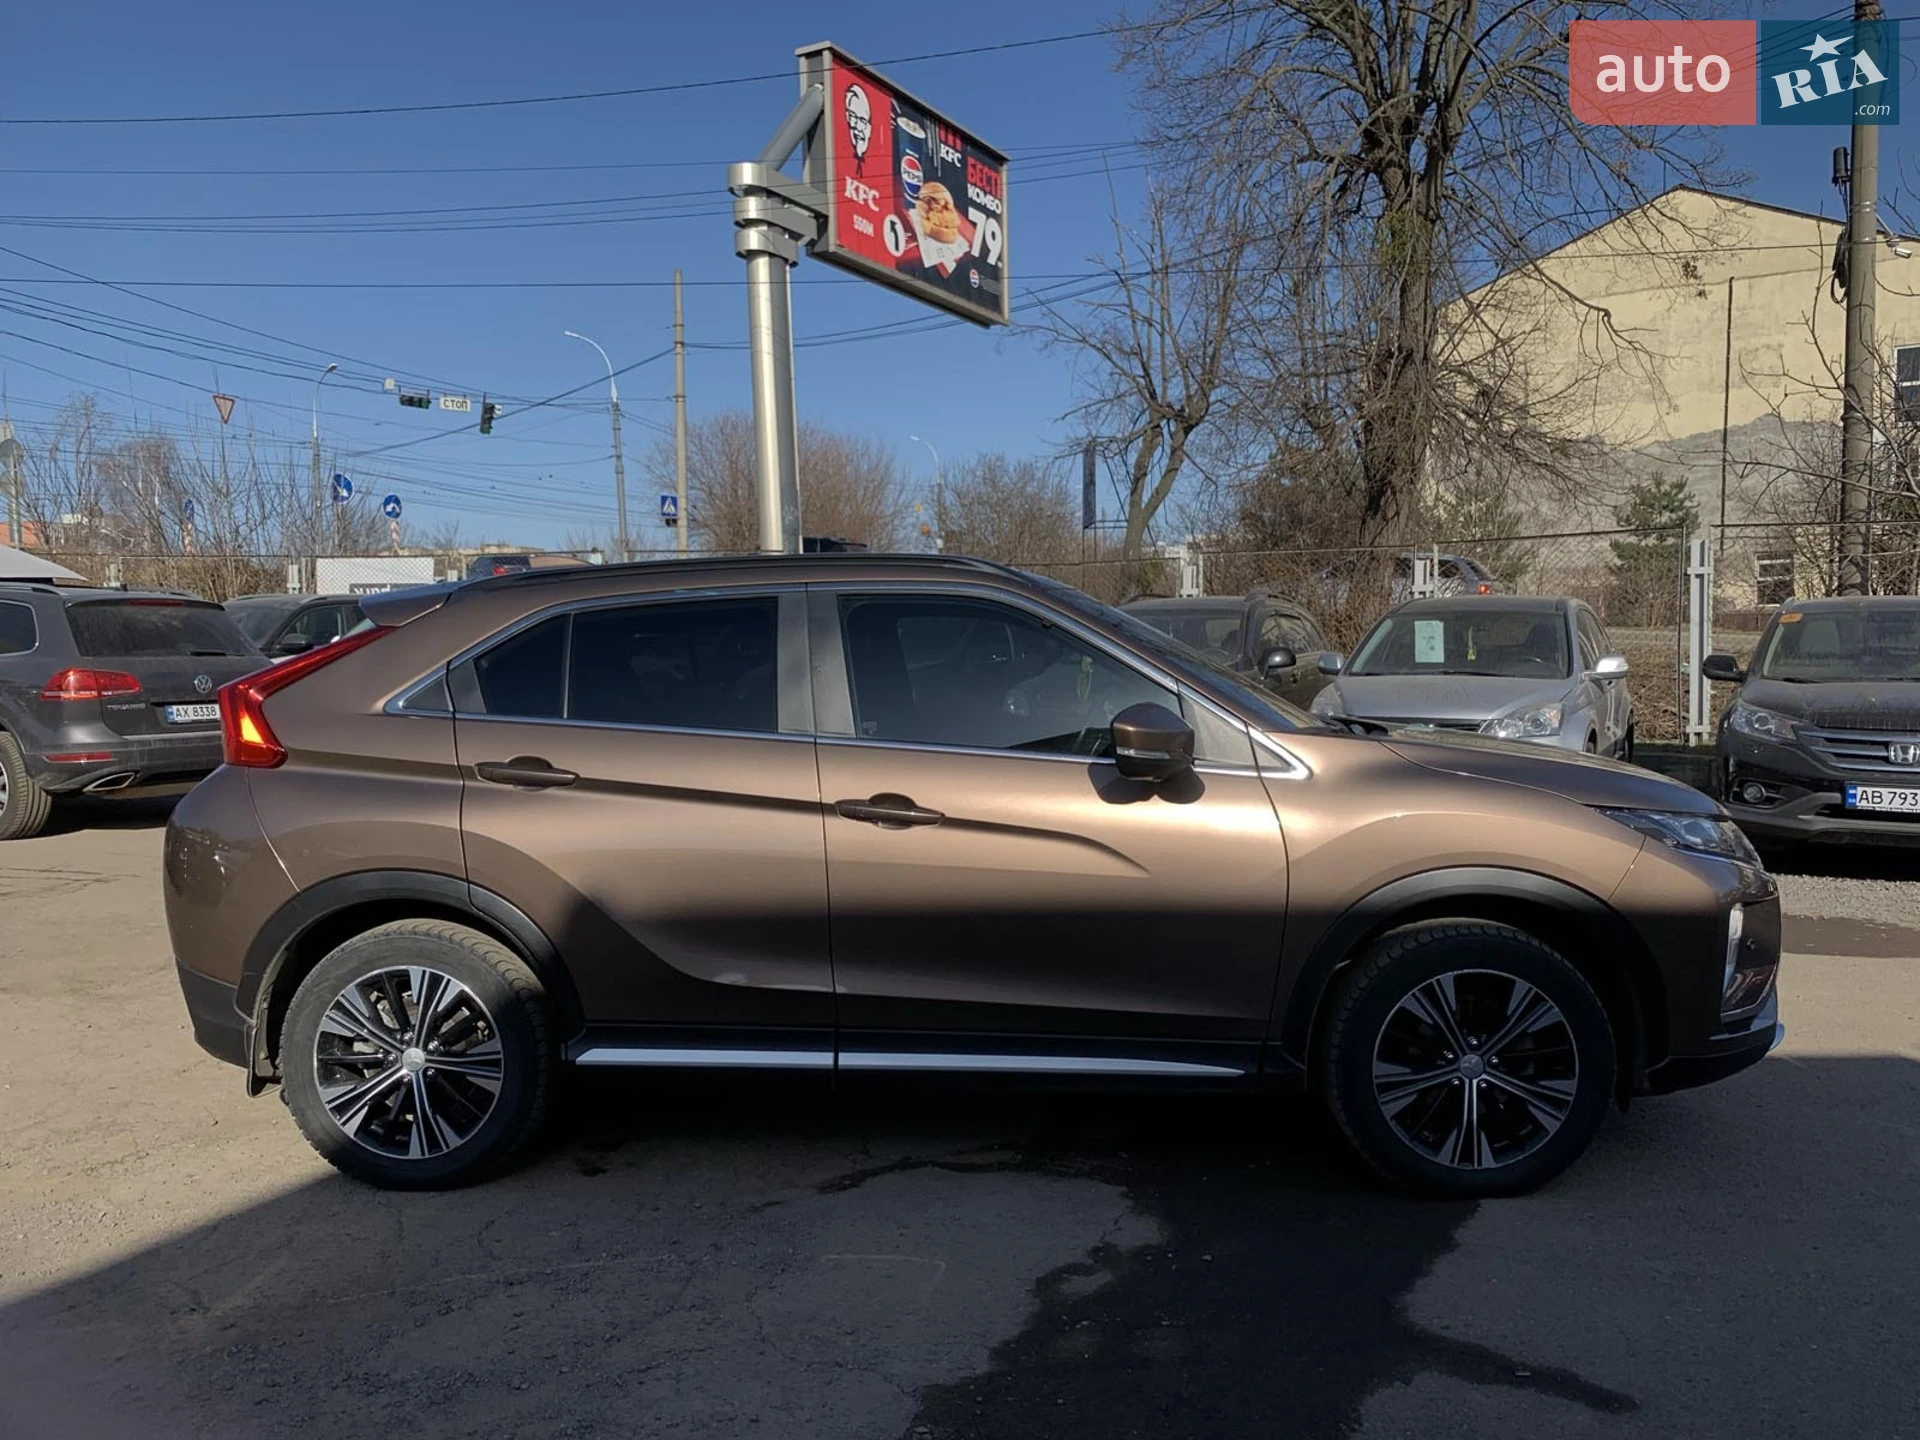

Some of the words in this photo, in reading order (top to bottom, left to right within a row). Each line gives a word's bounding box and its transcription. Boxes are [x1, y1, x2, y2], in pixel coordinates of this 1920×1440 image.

[940, 143, 962, 168] KFC
[845, 176, 880, 212] KFC
[443, 399, 468, 410] СТОП
[175, 706, 191, 718] AX
[193, 706, 217, 718] 8338
[1858, 789, 1884, 805] AB
[1887, 791, 1919, 807] 793
